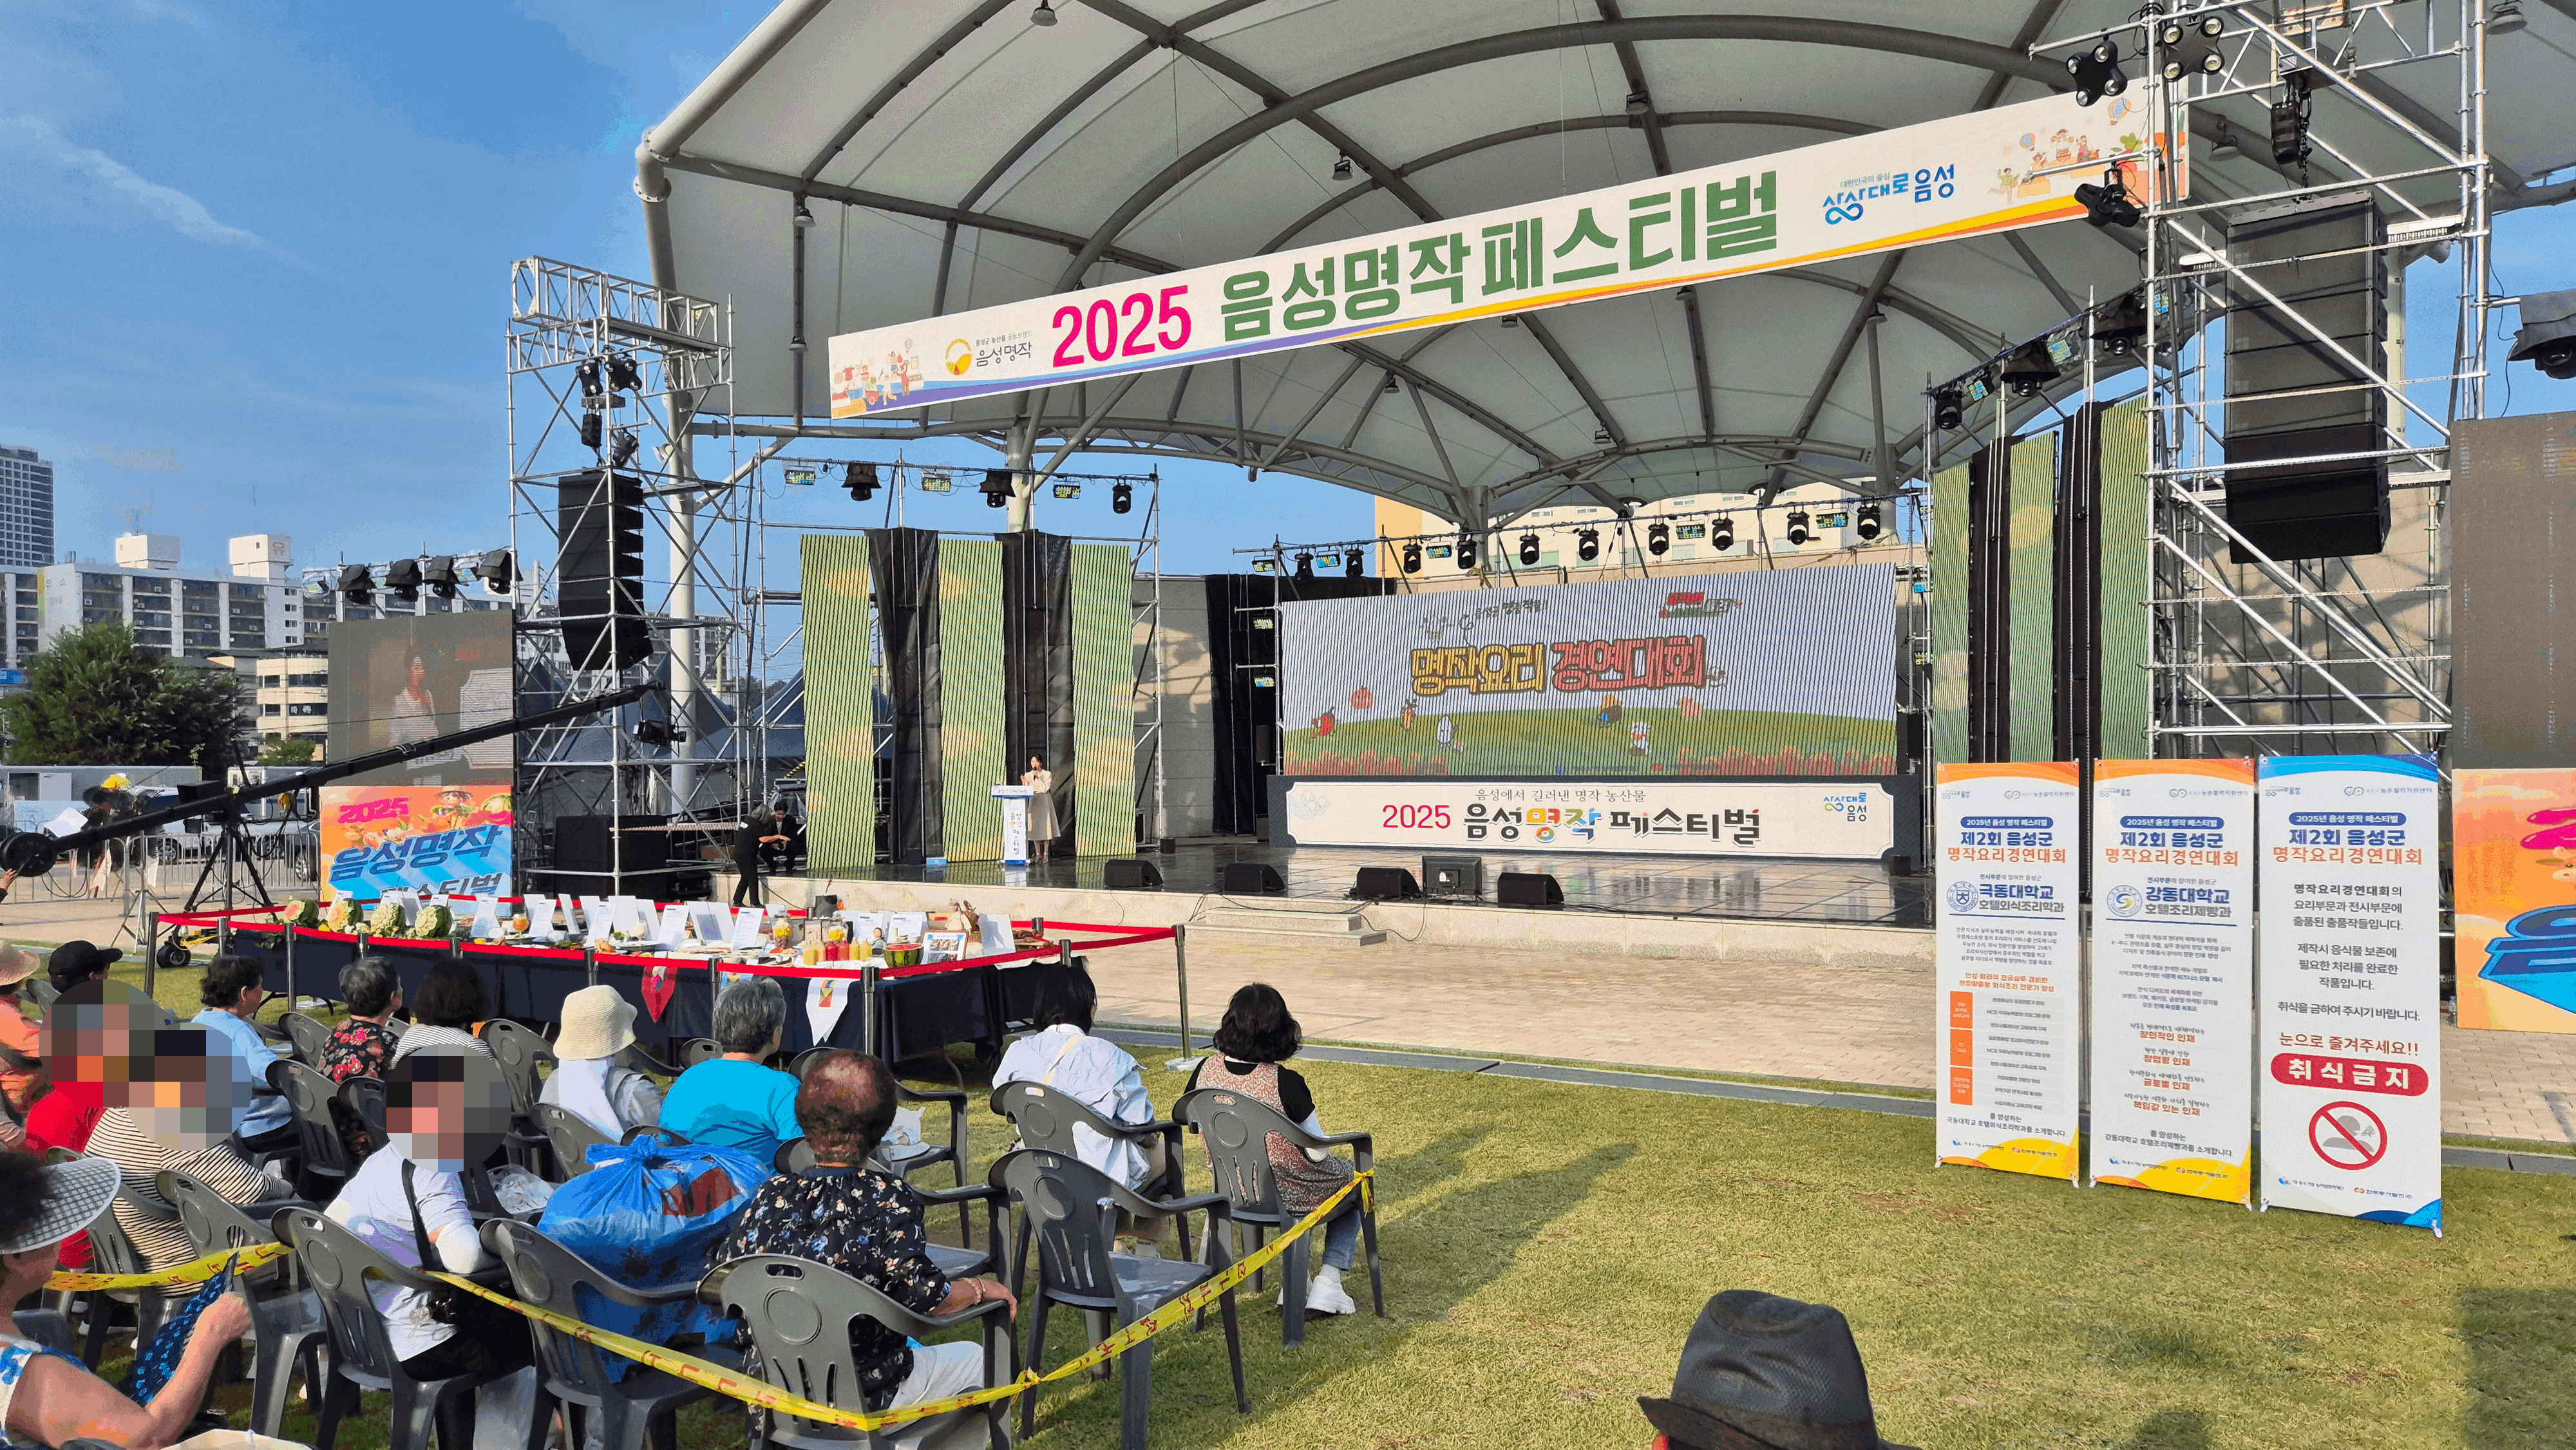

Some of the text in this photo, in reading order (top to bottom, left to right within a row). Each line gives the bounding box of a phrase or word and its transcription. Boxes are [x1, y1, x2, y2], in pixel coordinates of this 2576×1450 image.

[1841, 172, 1890, 187] 대한민국의 중심
[1823, 164, 1955, 225] 상상대로 음성
[1052, 285, 1191, 368] 2025
[976, 330, 1032, 346] 음성군 농산물 공동브랜드
[976, 341, 1032, 367] 음성명작
[1410, 635, 1706, 697] 명작요리 경연대회
[1476, 787, 1645, 804] 음성에서 길러낸 명작 농산물
[338, 797, 410, 824] 2025
[1847, 805, 1866, 822] 음성
[1383, 804, 1760, 846] 2025 음성명작 페스티벌
[2172, 819, 2186, 827] 명작
[2187, 819, 2217, 827] 페스티벌
[2329, 815, 2345, 824] 음성
[2347, 815, 2363, 824] 명작
[2365, 815, 2398, 824] 페스티벌
[1960, 831, 2052, 847] 제2회 음성군
[2120, 832, 2223, 848] 제2회 음성군
[2289, 829, 2406, 846] 제2회 음성군
[329, 824, 504, 883] 음성명작
[1947, 847, 2065, 863] 명작요리경연대회
[2105, 849, 2238, 866] 명작요리경연대회
[2273, 847, 2422, 865] 명작요리경연대회
[1979, 883, 2054, 899] 극동대학교
[2146, 887, 2230, 904] 강동대학교
[2293, 883, 2402, 898] 명작요리경연대회의
[1979, 899, 2065, 912] 호텔외식조리학과
[2145, 903, 2231, 918] 호텔조리제빵과
[2294, 900, 2402, 914] 요리부문과 전시부문에
[2293, 916, 2403, 931] 출품된 출품작들입니다.
[2297, 943, 2397, 958] 제작시 음식물 보존에
[2298, 959, 2398, 975] 필요한 처리를 완료한
[2319, 977, 2374, 990] 작품입니다.
[2277, 1001, 2421, 1022] 취식을 금하여 주시기 바랍니다.
[2140, 1030, 2195, 1043] 창의적인 인재
[2279, 1032, 2418, 1056] 눈으로 즐겨주세요!!
[2144, 1054, 2190, 1066] 창업형 인재
[2144, 1078, 2190, 1091] 글로벌 인재
[2134, 1100, 2200, 1116] 책임감 있는 인재
[1947, 1116, 1976, 1125] 극동대학교
[1978, 1120, 2032, 1133] 호텔외식조리학과를
[1998, 1114, 2022, 1123] 양성하는
[2105, 1133, 2138, 1144] 강동대학교
[2139, 1138, 2195, 1153] 호텔조리제빵과를
[2158, 1131, 2186, 1142] 양성하는
